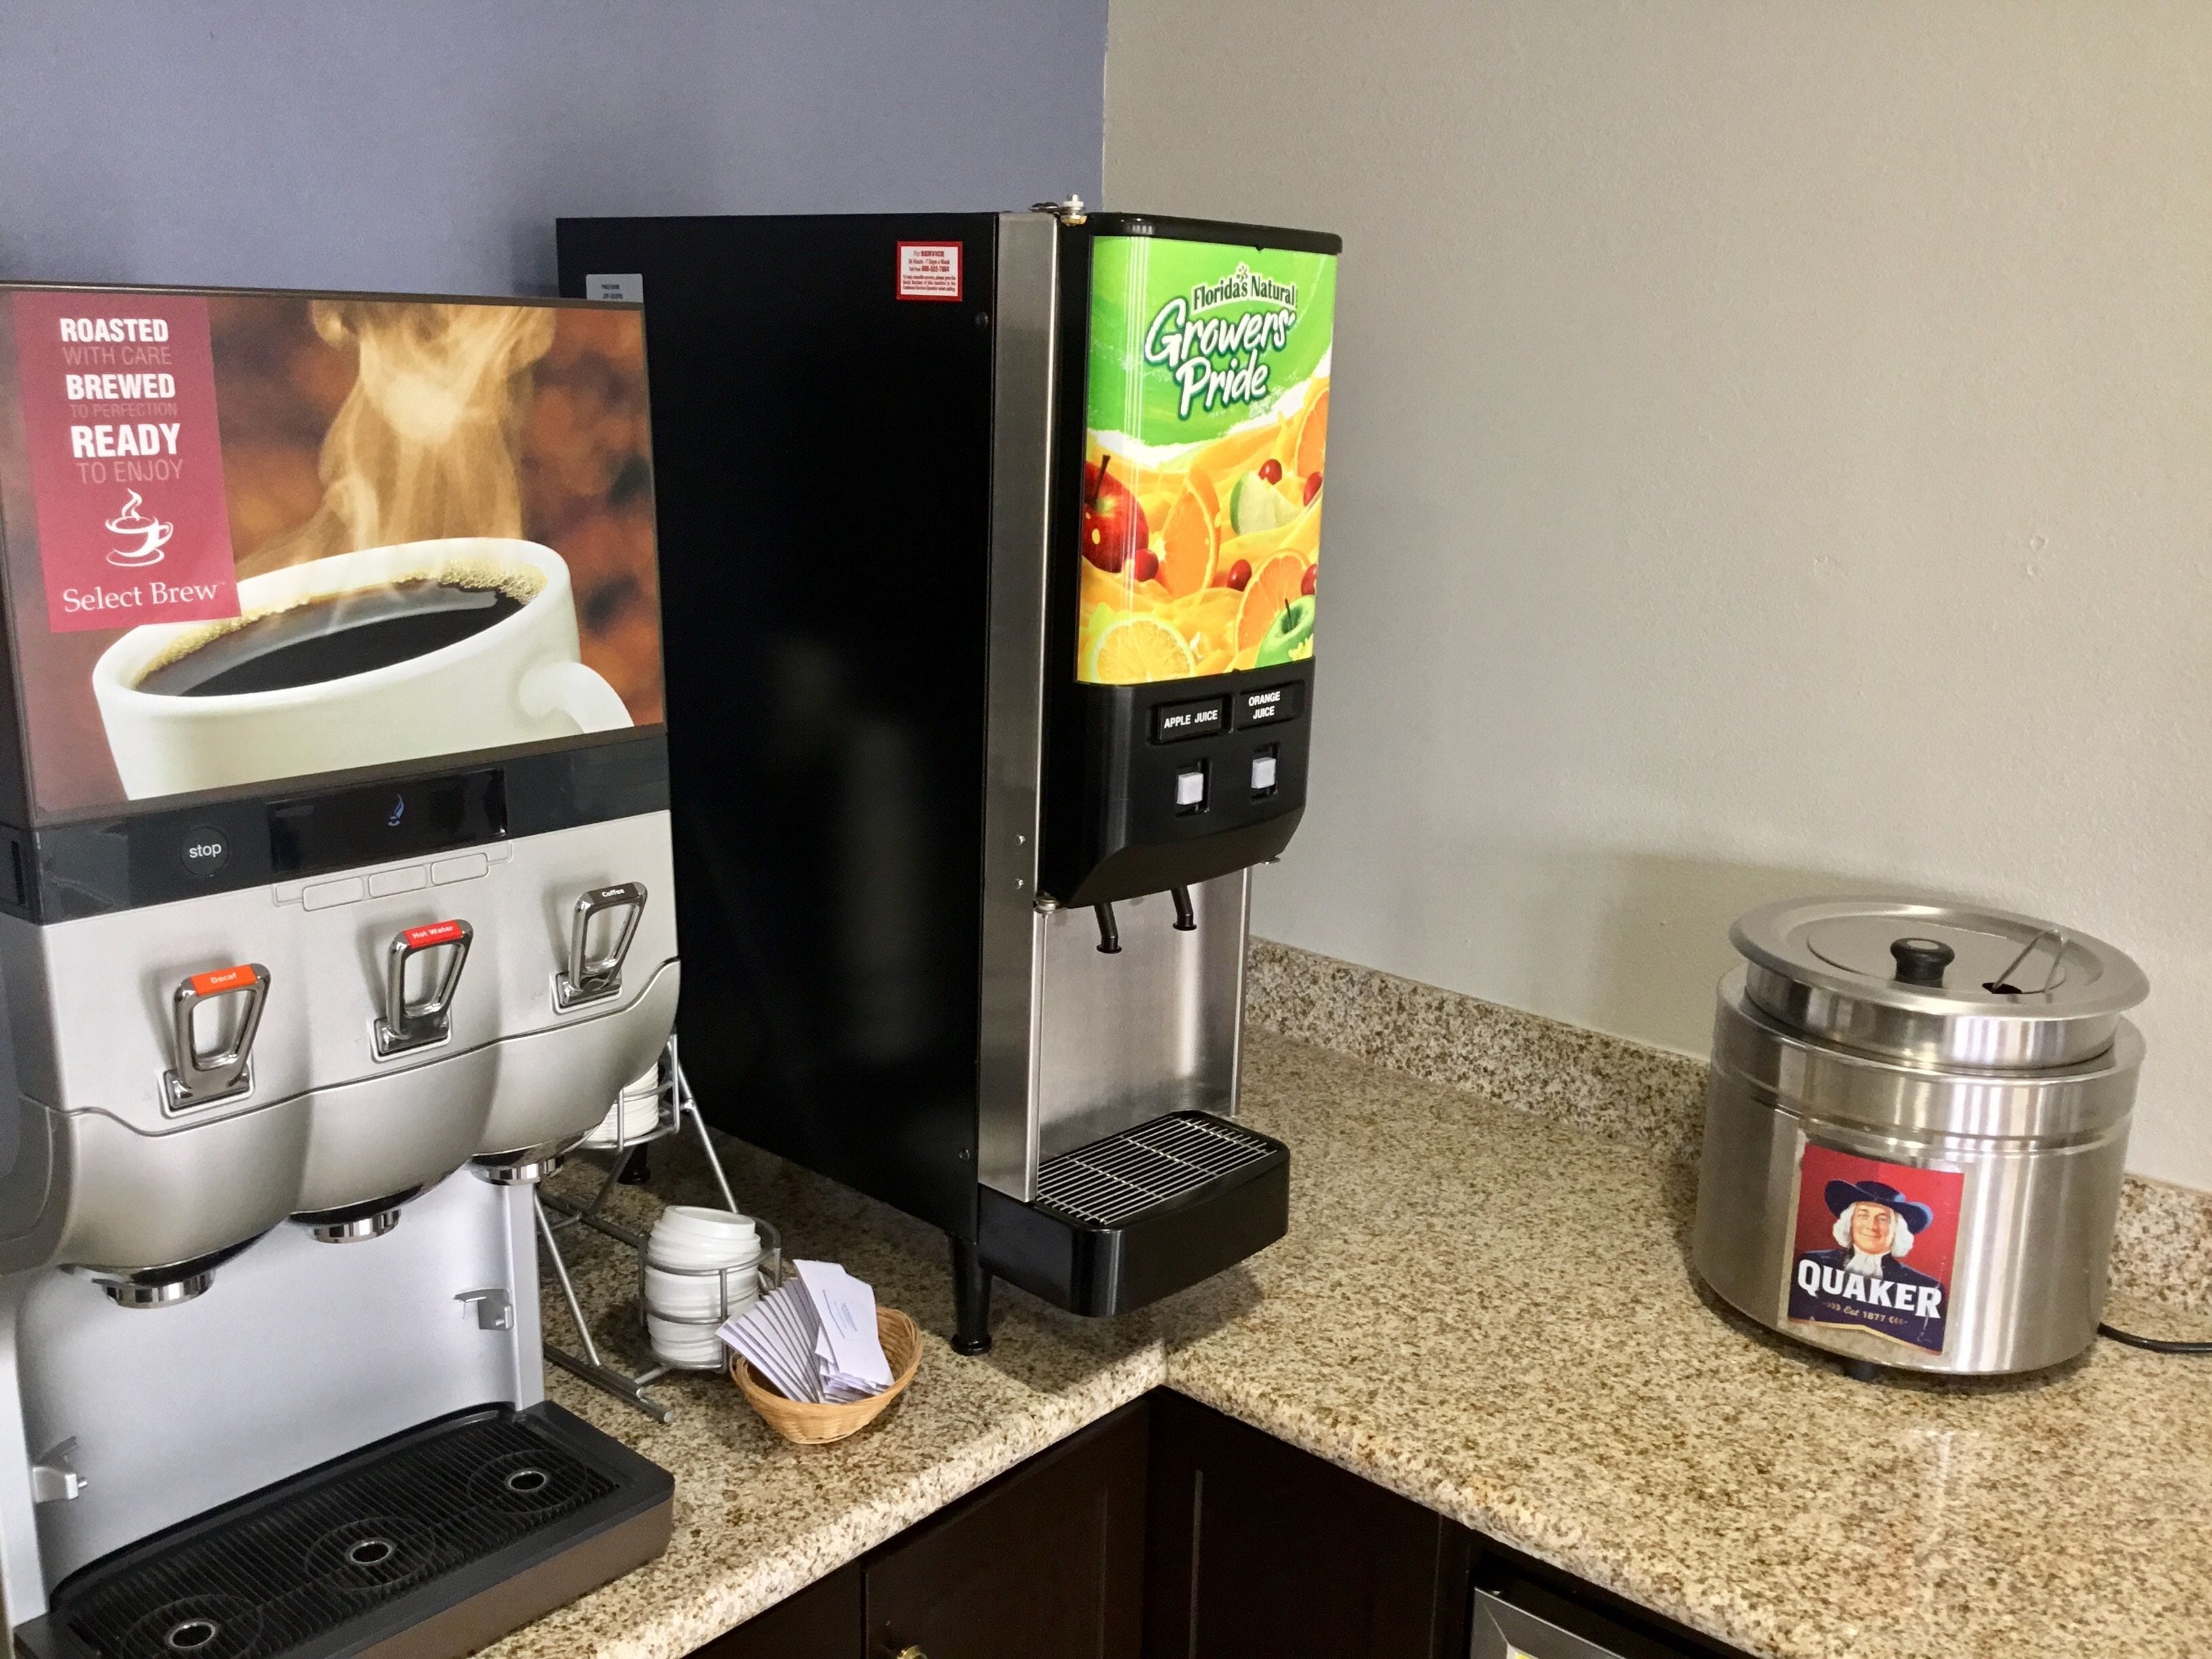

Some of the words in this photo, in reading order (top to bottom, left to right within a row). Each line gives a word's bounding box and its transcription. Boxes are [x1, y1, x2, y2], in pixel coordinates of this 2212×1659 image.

[1193, 275, 1248, 310] Florida's
[1251, 275, 1295, 306] Natural
[60, 318, 169, 342] ROASTED
[62, 346, 115, 365] WITH
[121, 346, 172, 365] CARE
[66, 373, 176, 400] BREWED
[1175, 348, 1269, 417] Pride
[68, 403, 89, 418] TO
[92, 402, 178, 417] PERFECTION
[70, 423, 181, 458] READY
[76, 462, 106, 485] TO
[114, 459, 183, 483] ENJOY
[63, 586, 143, 613] Select
[148, 581, 218, 605] Brew
[1248, 691, 1281, 706] ORANGE
[1164, 714, 1191, 729] APPLE
[1194, 710, 1218, 723] JUICE
[1253, 706, 1275, 720] JUICE
[189, 844, 222, 858] stop
[601, 888, 625, 897] Coffee
[411, 930, 428, 939] Hot
[428, 926, 453, 935] Water
[210, 972, 237, 984] Decaf
[1797, 1259, 1942, 1319] QUAKER
[1862, 1311, 1886, 1322] 1877
